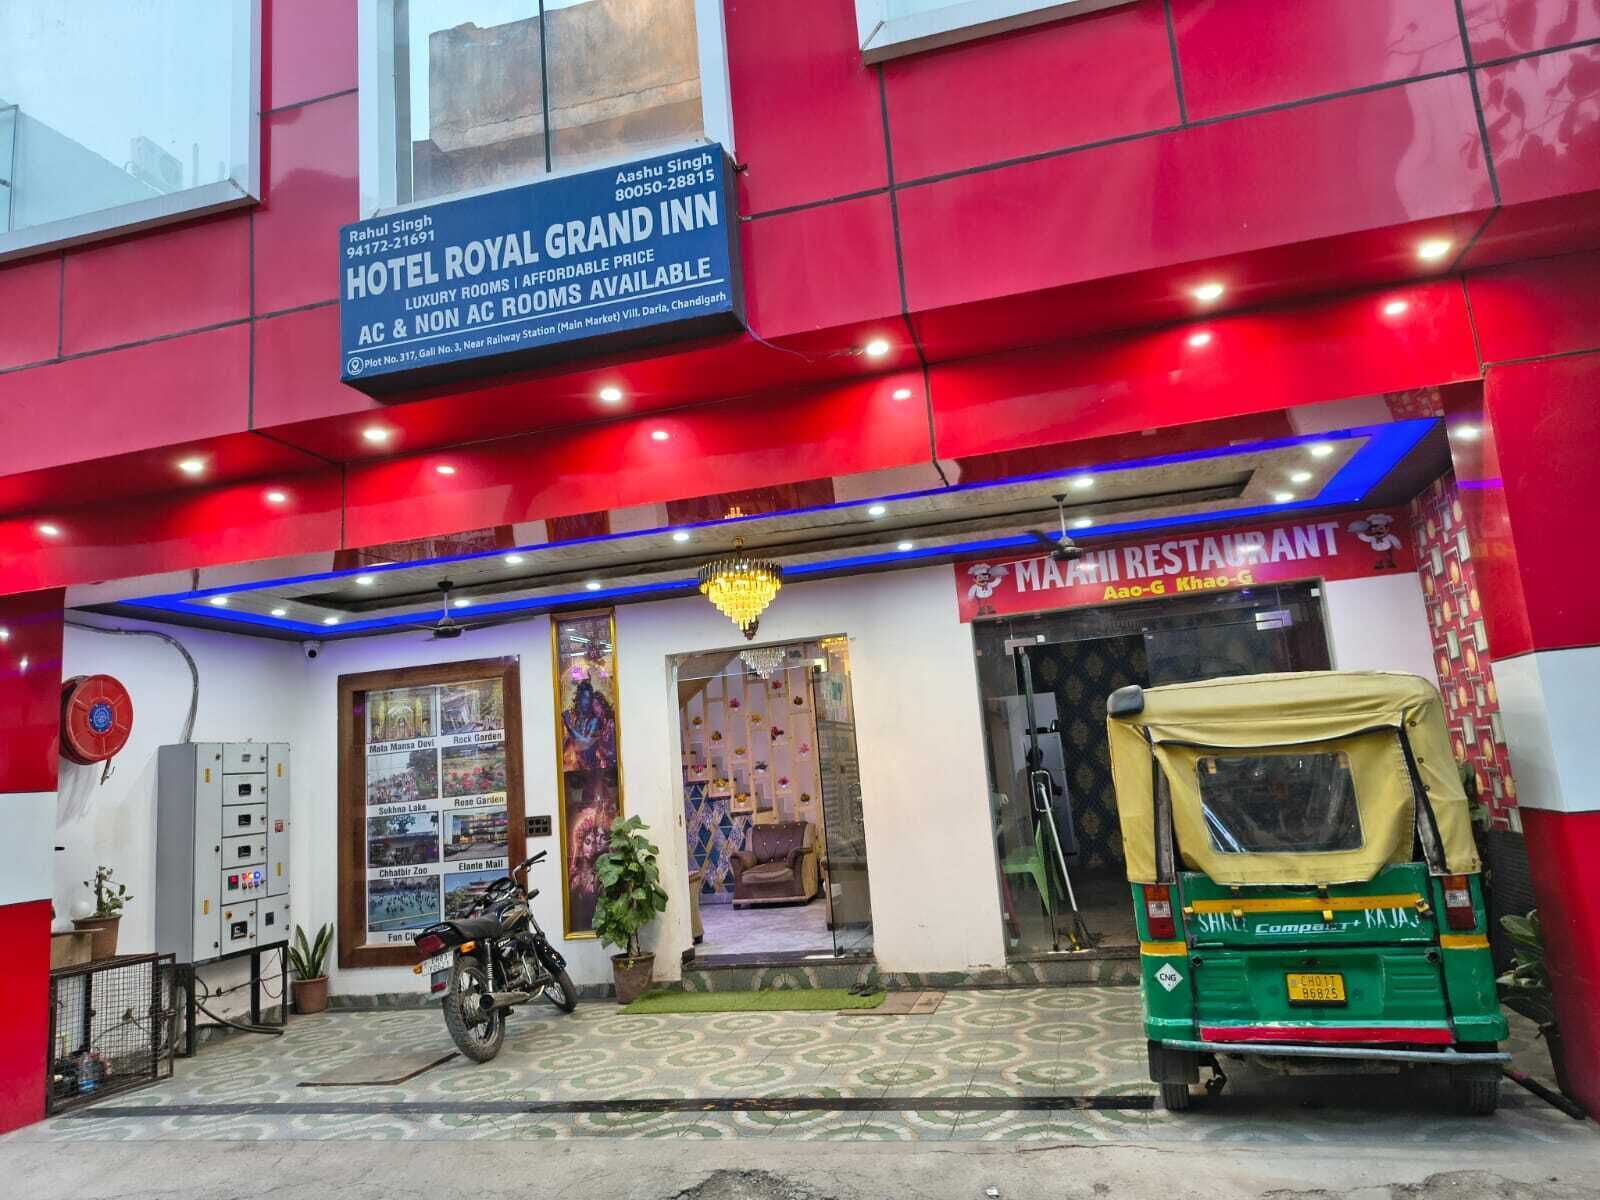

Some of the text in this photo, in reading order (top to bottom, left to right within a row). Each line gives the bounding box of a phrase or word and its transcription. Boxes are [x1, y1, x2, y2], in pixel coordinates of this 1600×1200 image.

[615, 153, 713, 186] Aashu Singh
[614, 168, 716, 202] 80050-28815
[350, 214, 433, 243] Rahul Singh
[346, 229, 436, 260] 94172-21691
[346, 190, 719, 301] HOTEL ROYAL GRAND INN
[405, 289, 457, 311] LUXURY
[461, 278, 510, 301] ROOMS
[522, 257, 610, 287] AFFORDABLE
[613, 248, 655, 270] PRICE
[358, 256, 712, 345] AC & NON AC ROOMS AVAILABLE
[364, 358, 382, 369] Plot
[383, 355, 399, 365] No.
[419, 347, 436, 358] Gali
[438, 344, 453, 354] No.
[463, 339, 485, 351] Near
[486, 330, 522, 347] Railway
[522, 323, 556, 339] Station
[557, 318, 583, 334] (Main
[585, 311, 621, 330] Market)
[671, 290, 727, 311] Chandigarh
[1014, 521, 1339, 593] MAAHI RESTAURANT
[1103, 569, 1254, 601] Aao-G Khao-G
[390, 741, 416, 752] Mansa
[417, 738, 435, 749] Devi
[453, 732, 502, 745] Rock Garden
[378, 803, 427, 816] Sukhna Lake
[454, 795, 504, 807] Rose Garden
[413, 866, 428, 876] Zoo
[458, 859, 503, 871] Elante Mall
[388, 932, 404, 942] Fun
[1159, 973, 1177, 982] CNG
